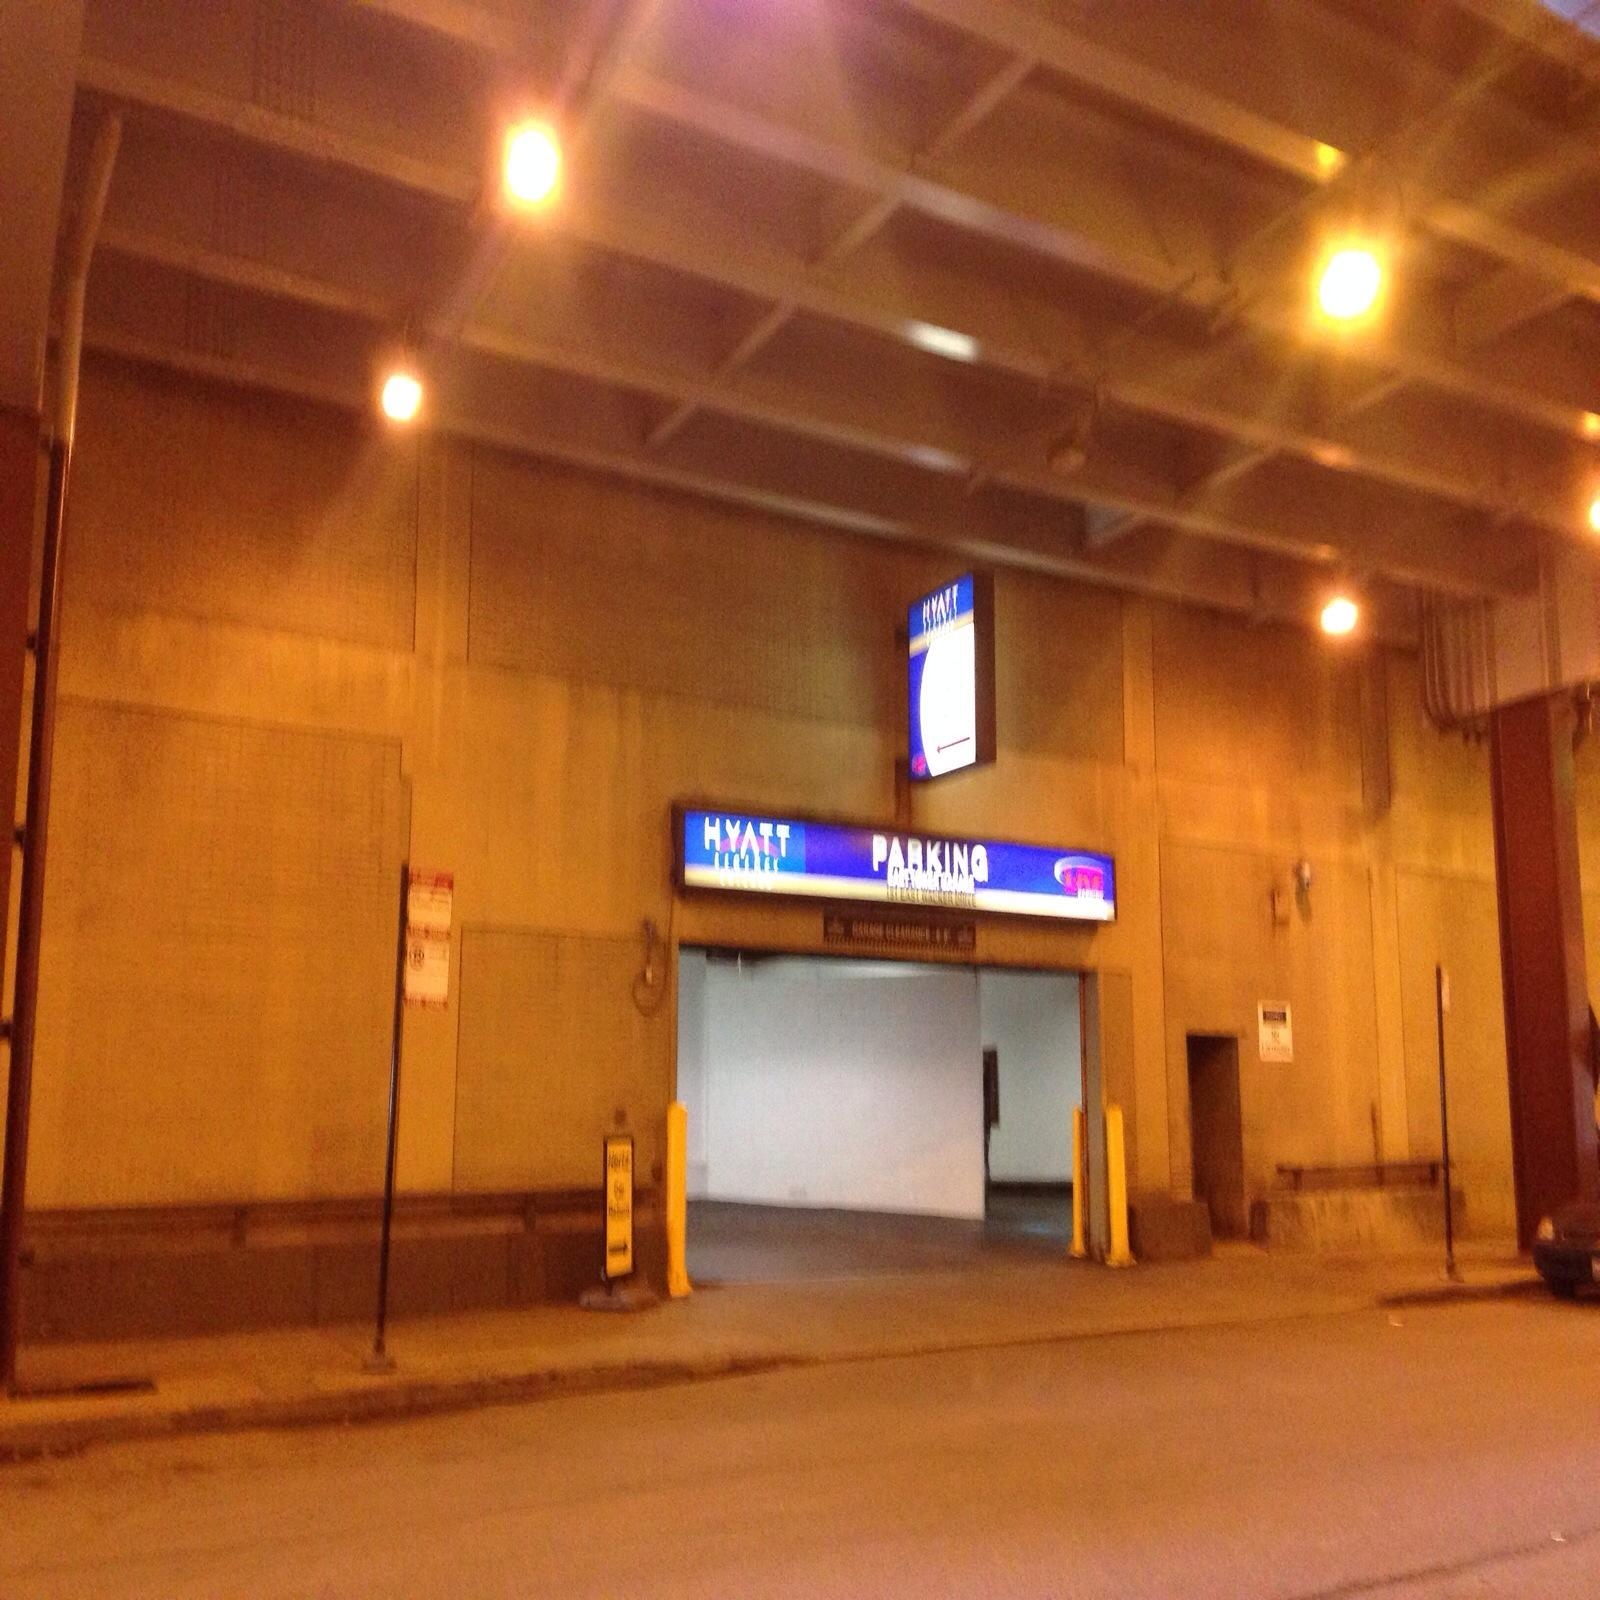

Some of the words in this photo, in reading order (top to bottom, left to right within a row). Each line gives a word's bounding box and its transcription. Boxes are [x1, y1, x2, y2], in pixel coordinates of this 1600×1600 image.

[922, 584, 959, 622] HYATT
[704, 816, 791, 859] HYATT
[872, 833, 989, 883] PARKING
